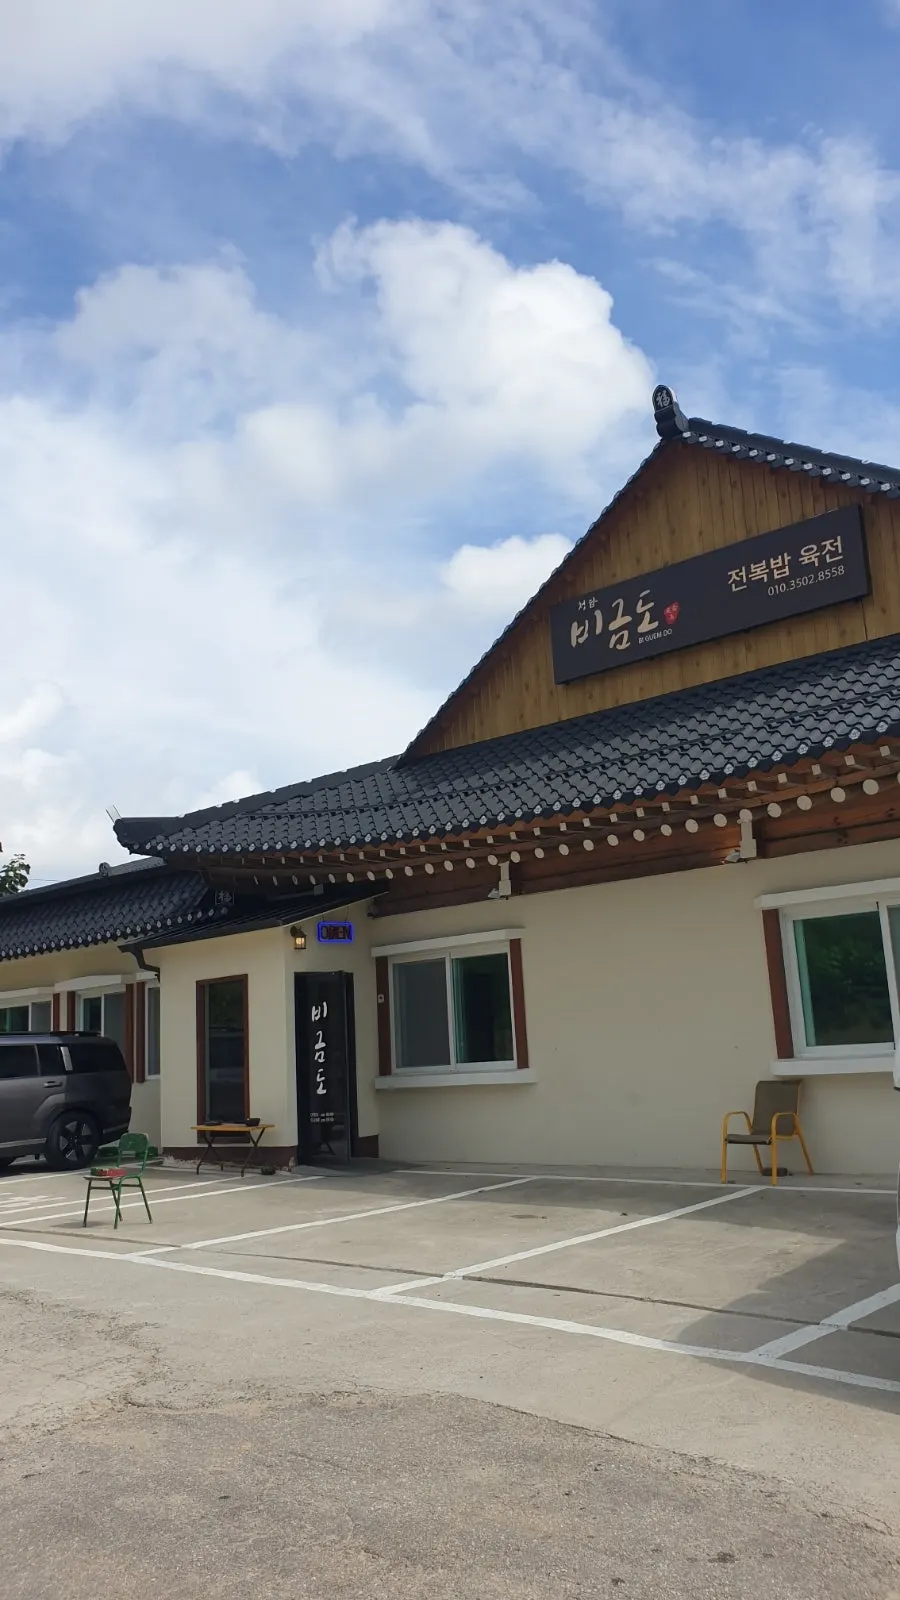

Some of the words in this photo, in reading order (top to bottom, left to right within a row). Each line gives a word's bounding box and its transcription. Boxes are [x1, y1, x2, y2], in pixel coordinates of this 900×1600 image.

[727, 552, 792, 593] 전복밥
[798, 535, 844, 567] 육전
[767, 565, 845, 596] 010.3502.8558
[570, 589, 659, 650] 비금도
[663, 628, 673, 637] DO
[311, 1001, 328, 1095] 비금도
